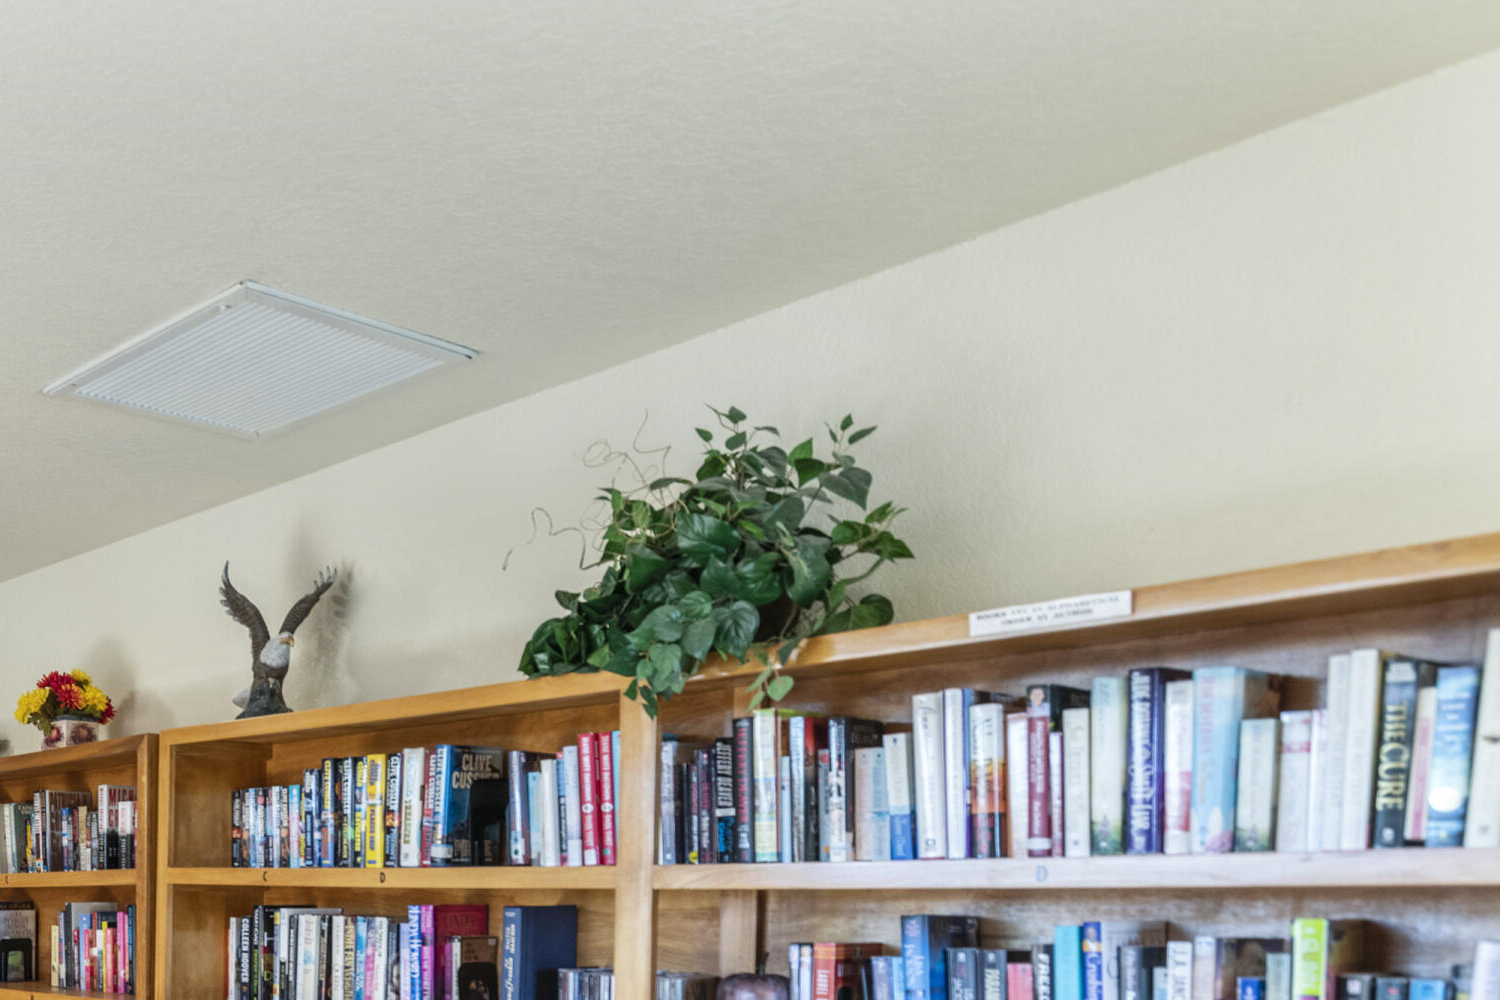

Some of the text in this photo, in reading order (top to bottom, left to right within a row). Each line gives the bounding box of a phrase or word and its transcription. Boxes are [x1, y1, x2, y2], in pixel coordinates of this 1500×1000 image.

[462, 753, 493, 771] CLIVE
[1376, 704, 1409, 811] THE CURE
[389, 756, 399, 811] CLIVE CUSSLER
[717, 776, 733, 807] DEAVER
[108, 788, 134, 805] MICH
[380, 871, 386, 883] D
[1036, 866, 1049, 882] D
[242, 917, 250, 983] COLLEEN HOOVER
